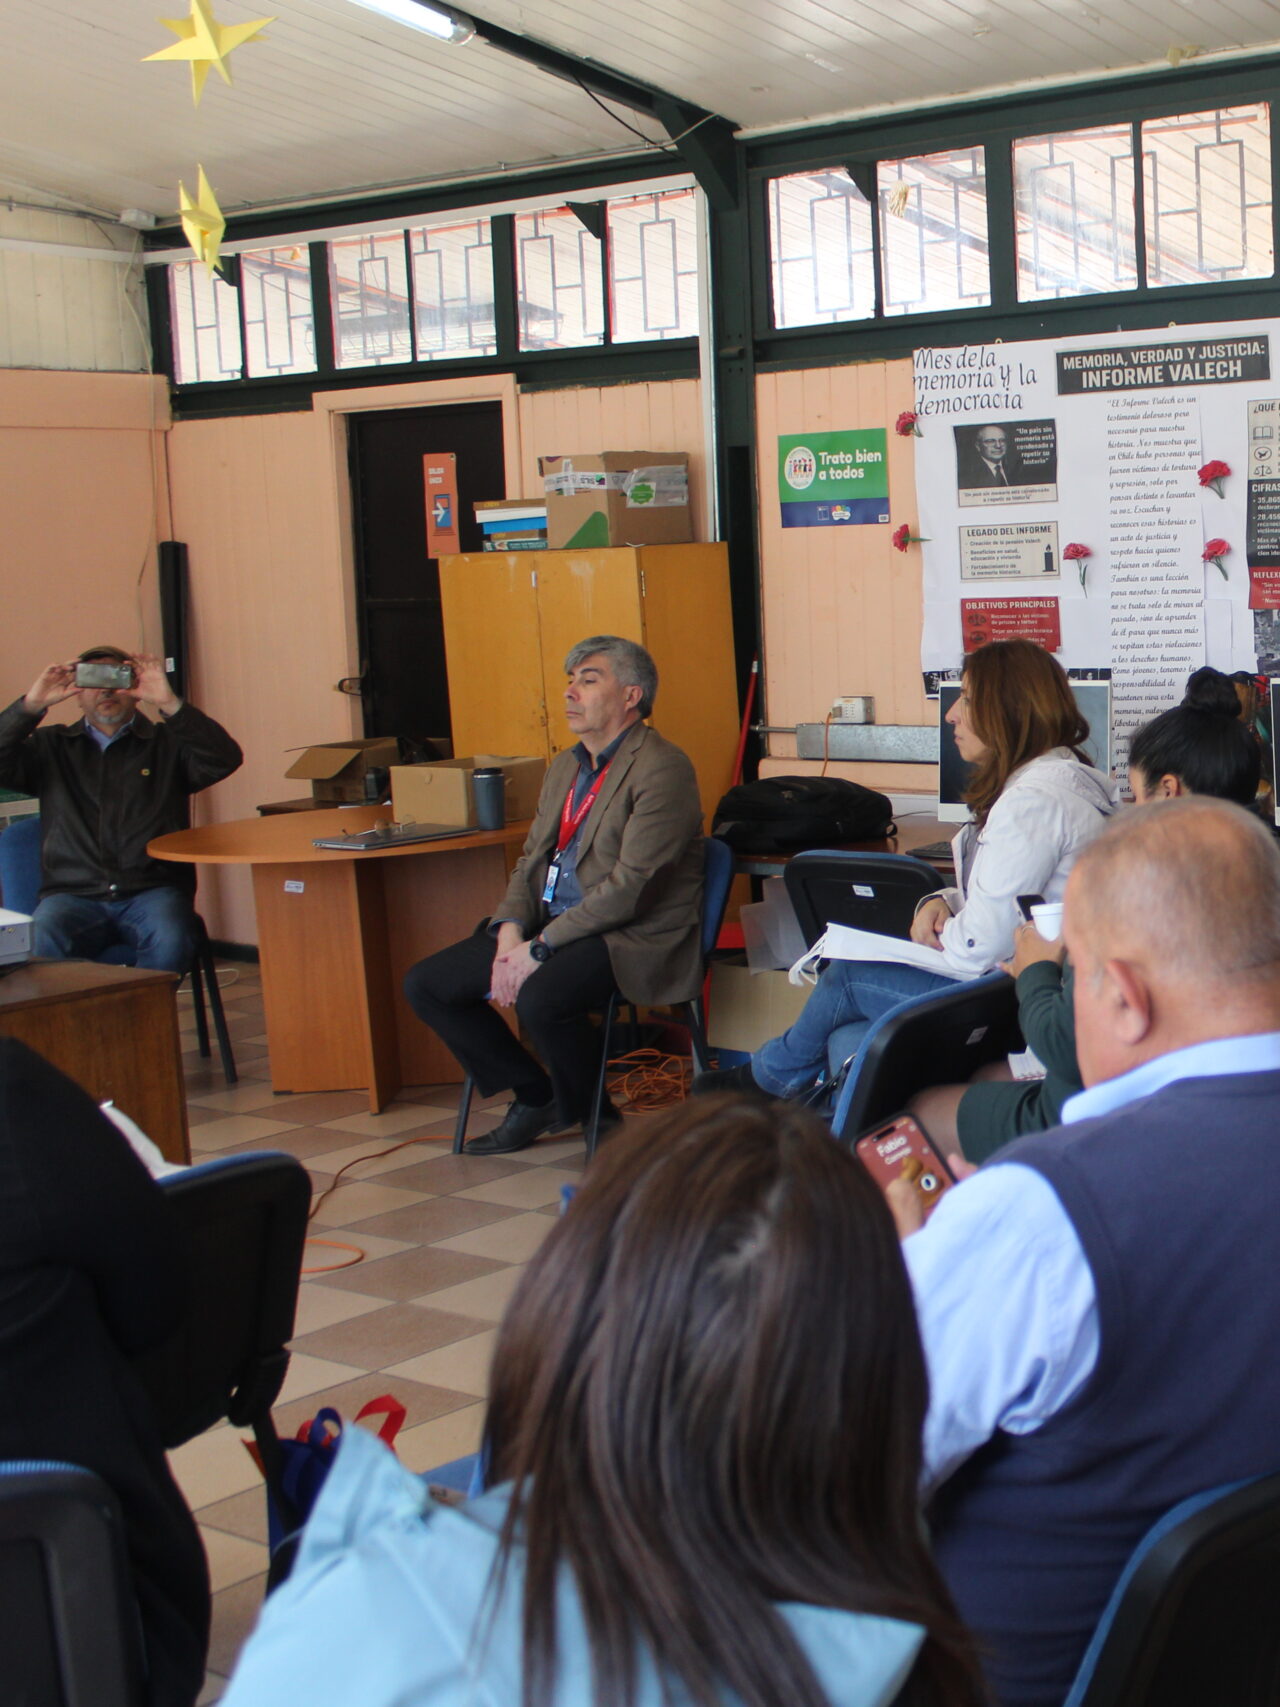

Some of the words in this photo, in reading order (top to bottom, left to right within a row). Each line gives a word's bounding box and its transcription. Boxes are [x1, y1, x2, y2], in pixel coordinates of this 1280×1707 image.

[916, 349, 951, 369] Mes
[1063, 353, 1128, 370] MEMORIA,
[1131, 348, 1183, 364] VERDAD
[1188, 347, 1195, 360] Y
[1200, 342, 1265, 359] JUSTICIA:
[913, 367, 993, 390] memoria
[1020, 363, 1037, 386] la
[1083, 365, 1164, 388] INFORME
[1169, 360, 1242, 382] VALECH
[914, 388, 1024, 416] democracia
[819, 451, 853, 465] Trato
[856, 449, 882, 463] bien
[819, 471, 826, 480] a
[829, 466, 864, 480] todos
[967, 528, 998, 537] LEGADO
[1017, 525, 1052, 534] INFORME
[1010, 600, 1055, 608] PRINCIPALES
[876, 1136, 907, 1157] Fabio
